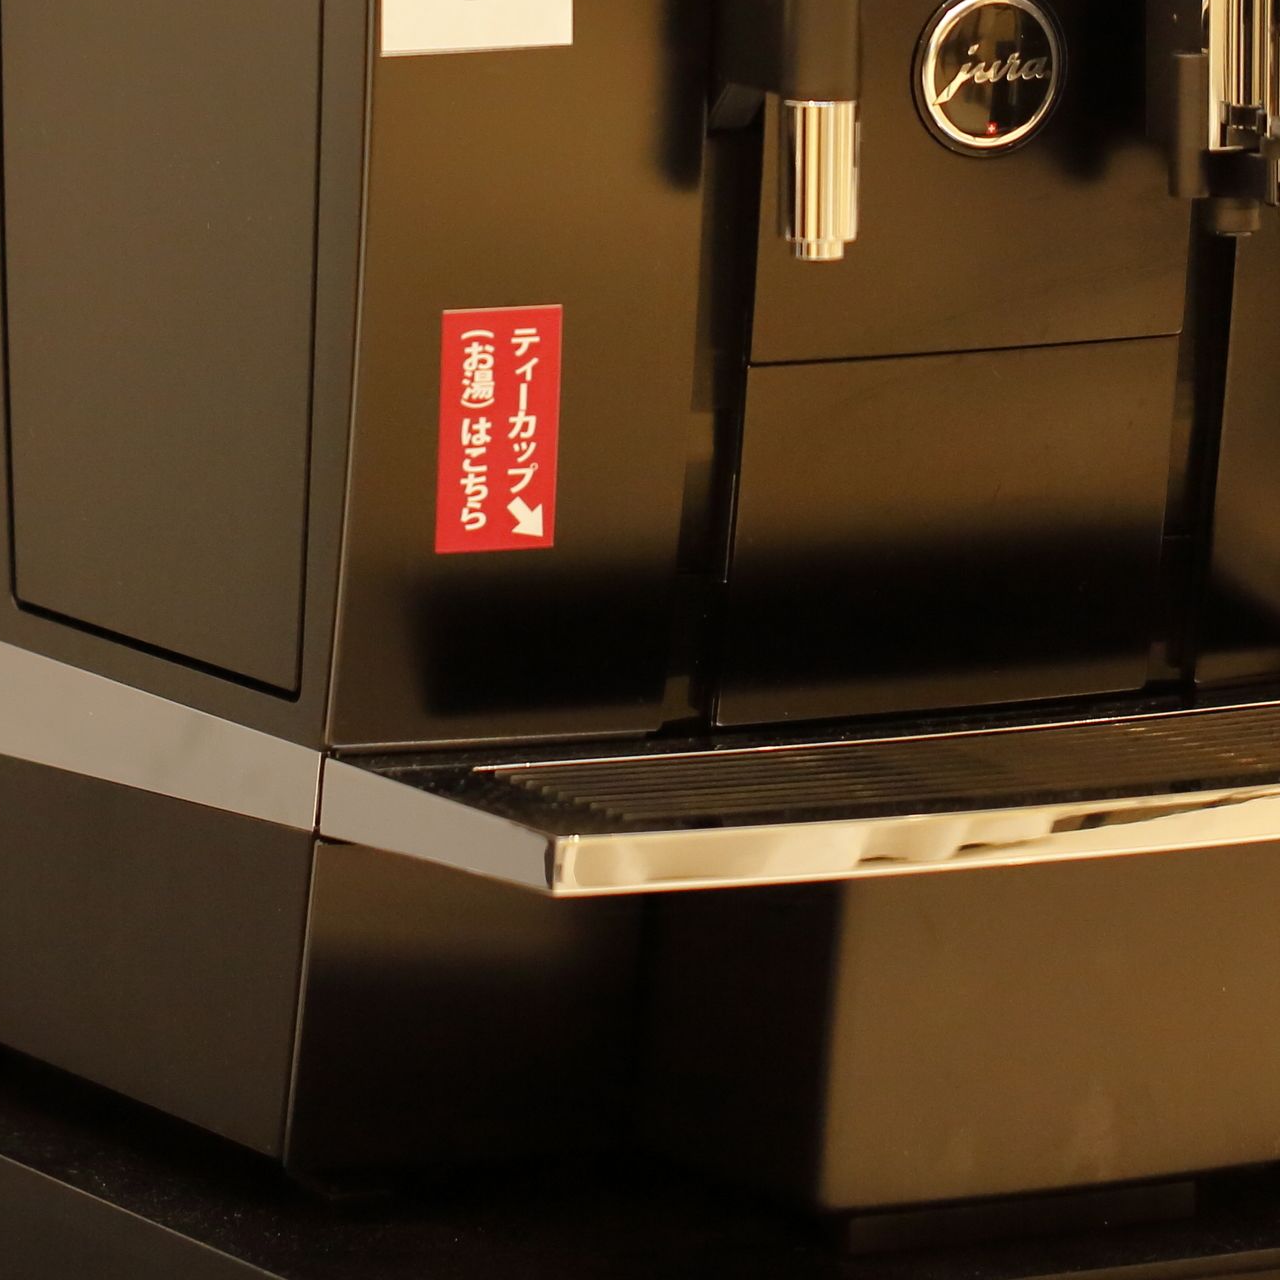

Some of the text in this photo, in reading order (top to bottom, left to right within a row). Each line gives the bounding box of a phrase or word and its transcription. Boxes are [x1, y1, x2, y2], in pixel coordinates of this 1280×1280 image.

[933, 45, 1048, 106] jura
[507, 327, 540, 494] ティーカップ
